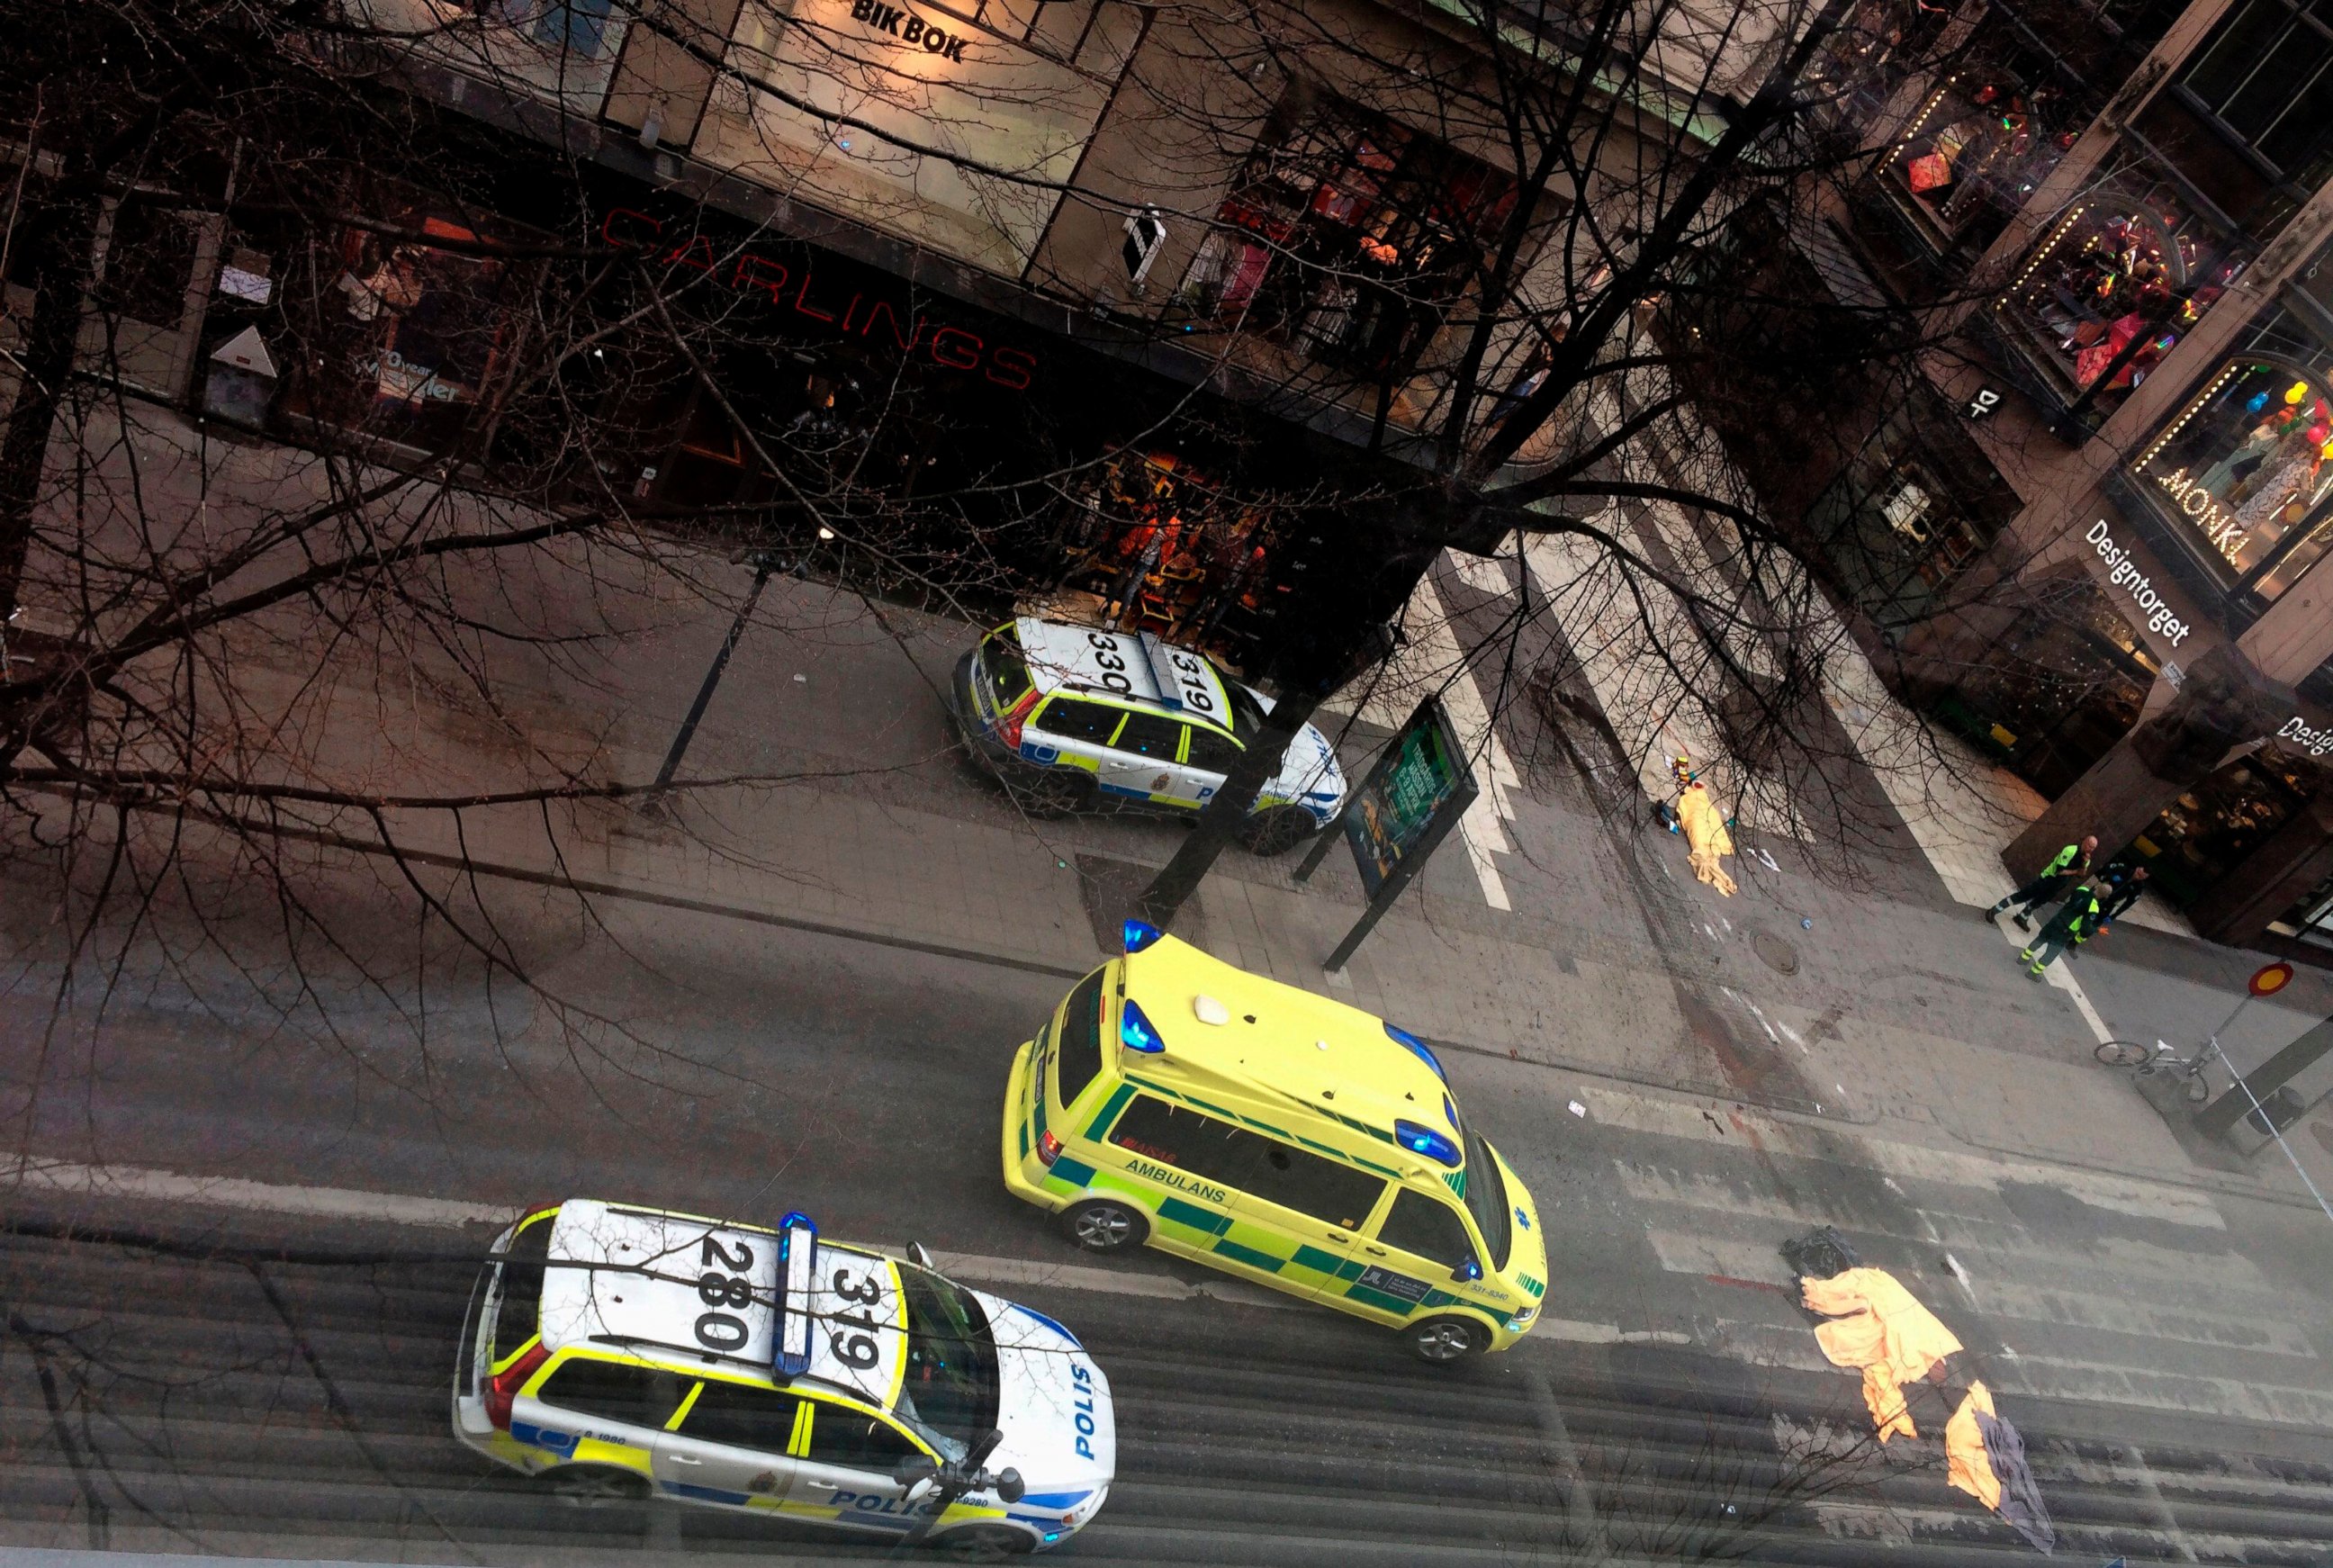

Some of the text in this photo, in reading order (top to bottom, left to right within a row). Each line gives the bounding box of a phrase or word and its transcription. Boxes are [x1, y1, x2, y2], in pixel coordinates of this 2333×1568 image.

[851, 0, 968, 64] BIK BOK
[602, 208, 1037, 390] CARLINGS
[2157, 467, 2249, 567] MONKI
[2085, 519, 2190, 647] Designtorget
[1087, 633, 1132, 694] 330
[1172, 653, 1213, 712] 319
[2277, 716, 2333, 755] Desig
[1125, 1159, 1226, 1203] AMBULANS
[694, 1237, 754, 1352] 280
[831, 1268, 881, 1371] 319
[1071, 1364, 1095, 1462] POLIS
